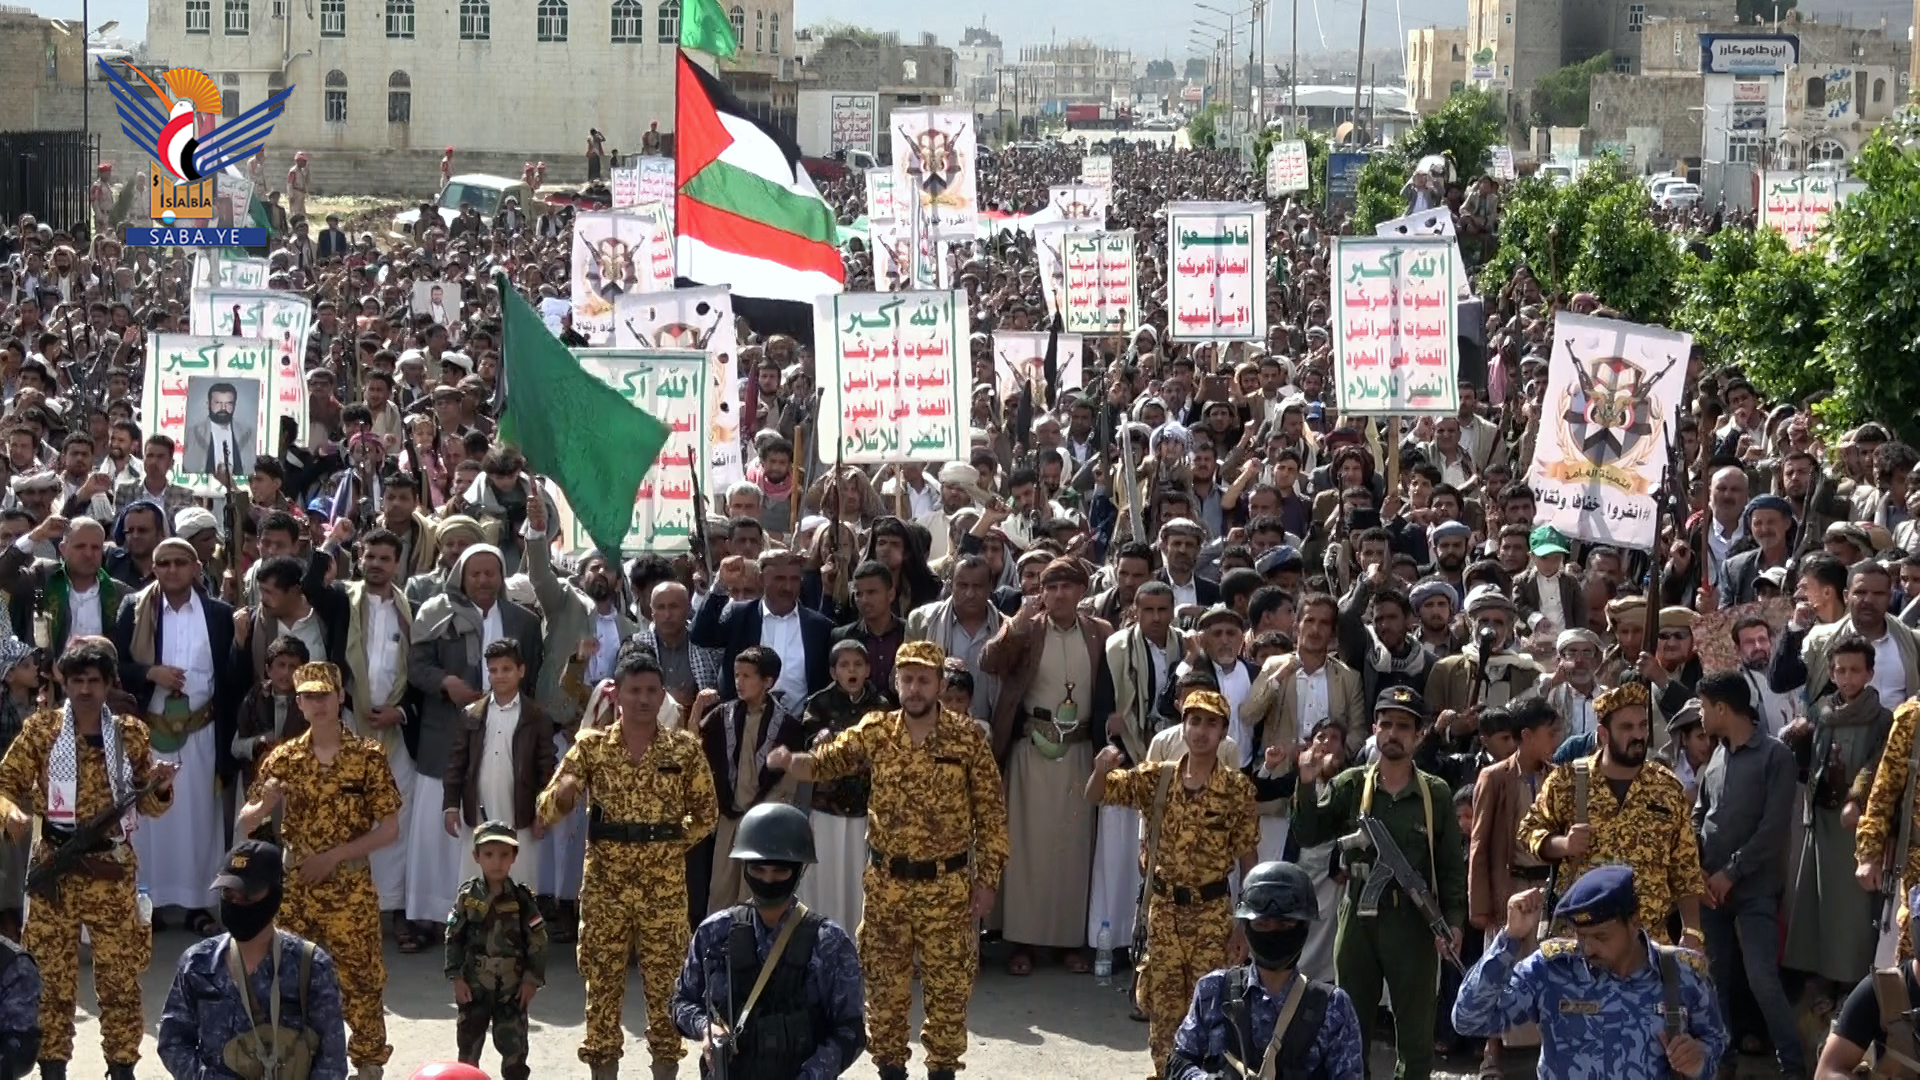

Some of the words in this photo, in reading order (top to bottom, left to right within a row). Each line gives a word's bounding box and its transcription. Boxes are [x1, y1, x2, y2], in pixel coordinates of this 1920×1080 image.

[1178, 225, 1248, 250] قاطعوا
[1216, 255, 1248, 277] البضائع
[1344, 246, 1404, 287] أكبر
[1408, 250, 1446, 278] الله
[910, 298, 949, 327] الله
[1403, 290, 1446, 311] الموت
[841, 296, 906, 337] أكبر
[1403, 320, 1446, 340] الموت
[162, 340, 225, 375] أكبر
[227, 345, 266, 369] الله
[904, 339, 949, 361] الموت
[1346, 348, 1384, 370] اليهود
[1389, 348, 1410, 370] على
[1415, 348, 1447, 366] اللعنة
[656, 367, 698, 398] الله
[905, 368, 950, 391] الموت
[1348, 375, 1399, 406] للإسلام
[1406, 372, 1448, 403] النصر
[844, 398, 884, 421] اليهود
[889, 399, 910, 421] على
[917, 398, 951, 416] اللعنة
[845, 427, 899, 459] للإسلام
[906, 423, 951, 457] النصر
